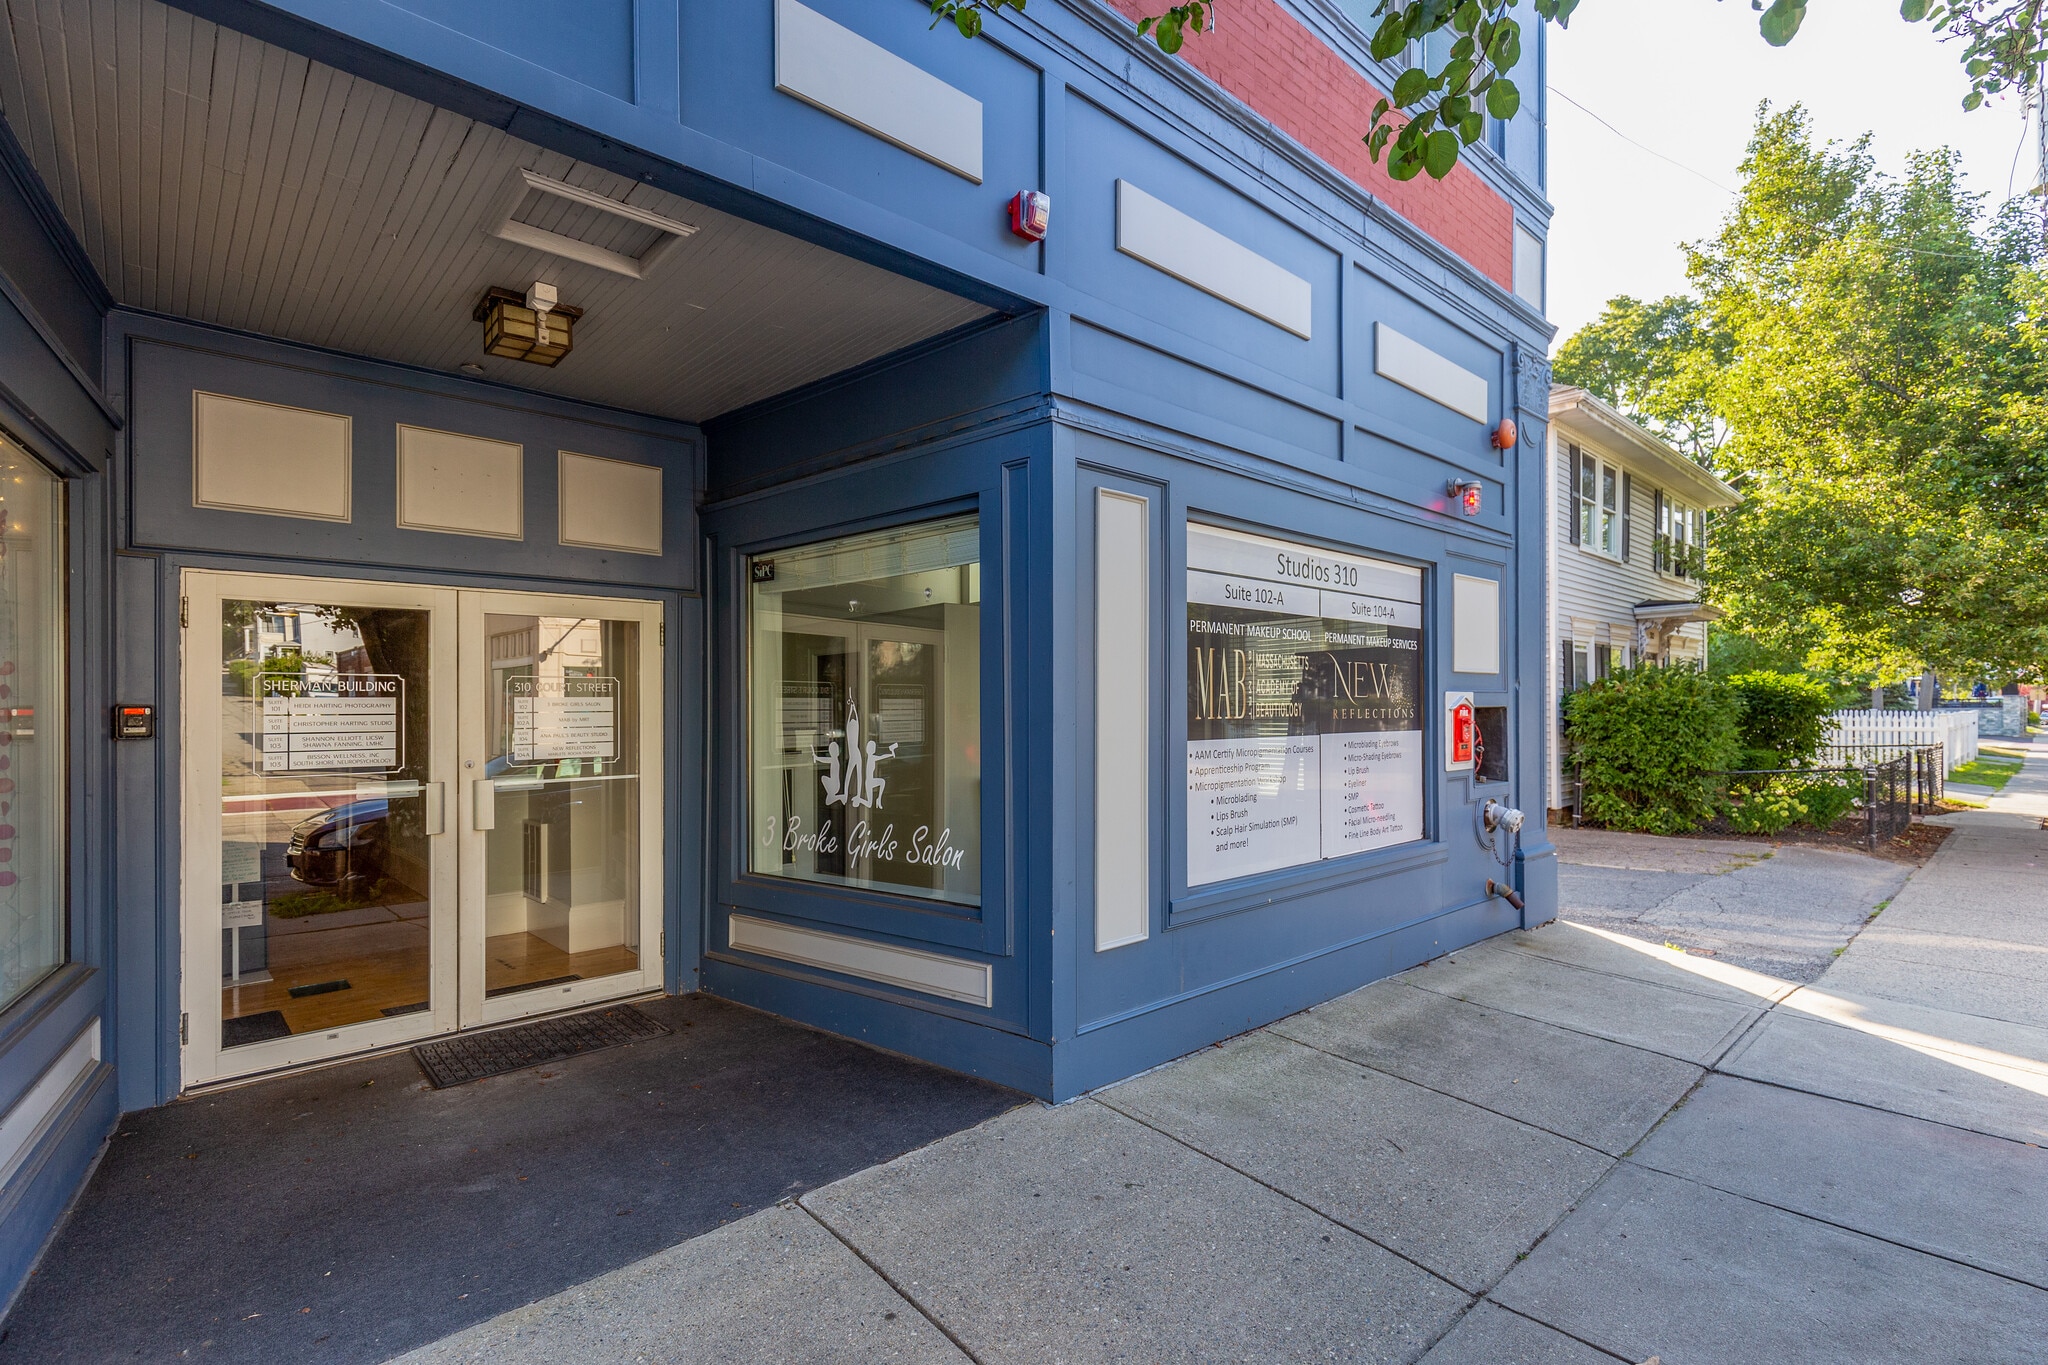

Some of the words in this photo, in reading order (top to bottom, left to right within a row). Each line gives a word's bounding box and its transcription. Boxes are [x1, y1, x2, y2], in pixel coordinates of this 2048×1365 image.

[1277, 553, 1330, 583] Studios
[1334, 564, 1358, 587] 310
[1225, 584, 1252, 602] Suite
[1255, 588, 1284, 606] 102-A
[1351, 602, 1372, 617] Suite
[1373, 605, 1395, 620] 104-A
[1190, 619, 1246, 637] PERMANENT
[1247, 624, 1281, 639] MAKEUP
[1282, 628, 1313, 642] SCHOOL
[1324, 631, 1365, 645] PERMANENT
[1366, 636, 1392, 648] MAKEUP
[1392, 639, 1418, 651] SERVICES
[263, 680, 332, 692] SHERMAN
[338, 681, 396, 692] BUILDING
[1195, 646, 1247, 720] MAB
[1327, 652, 1397, 706] NEW
[514, 682, 531, 692] 310
[536, 682, 572, 693] COURT
[576, 682, 613, 692] STREET
[1255, 679, 1291, 694] ACADEMY
[1292, 680, 1300, 694] OF
[1332, 708, 1415, 719] REFLECTIONS
[1348, 740, 1378, 749] Microblading
[1378, 739, 1399, 749] Eyebrows
[1195, 750, 1211, 760] AAM
[1213, 749, 1235, 760] Certify
[1293, 745, 1314, 754] Courses
[1348, 752, 1381, 762] Micro-Shading
[1381, 751, 1402, 760] Eyebrows
[1195, 764, 1243, 777] Apprenticeship
[1245, 763, 1271, 774] Program
[1356, 766, 1369, 775] Brush
[1195, 777, 1256, 791] Micropigmentation
[1348, 779, 1367, 788] Eyeliner
[1216, 793, 1258, 806] Microblading
[1348, 792, 1359, 801] SMP
[1216, 810, 1229, 822] Lips
[1230, 808, 1249, 819] Brush
[1348, 804, 1370, 814] Cosmetic
[1370, 802, 1384, 811] Tattoo
[1216, 825, 1234, 837] Scalp
[1234, 822, 1248, 834] Hair
[1248, 819, 1280, 831] Simulation
[1281, 815, 1298, 828] (SMP)
[1348, 816, 1361, 827] Facial
[1362, 813, 1396, 824] Micro-needling
[1348, 830, 1359, 839] Fine
[1360, 829, 1369, 838] Line
[1370, 827, 1381, 837] Body
[1381, 825, 1389, 833] Art
[1390, 823, 1403, 832] Tattoo
[762, 815, 778, 847] 3
[783, 815, 838, 855] Broke
[847, 820, 898, 869] Girls
[906, 825, 966, 871] Salon
[1215, 841, 1229, 852] and
[1229, 838, 1249, 850] more!
